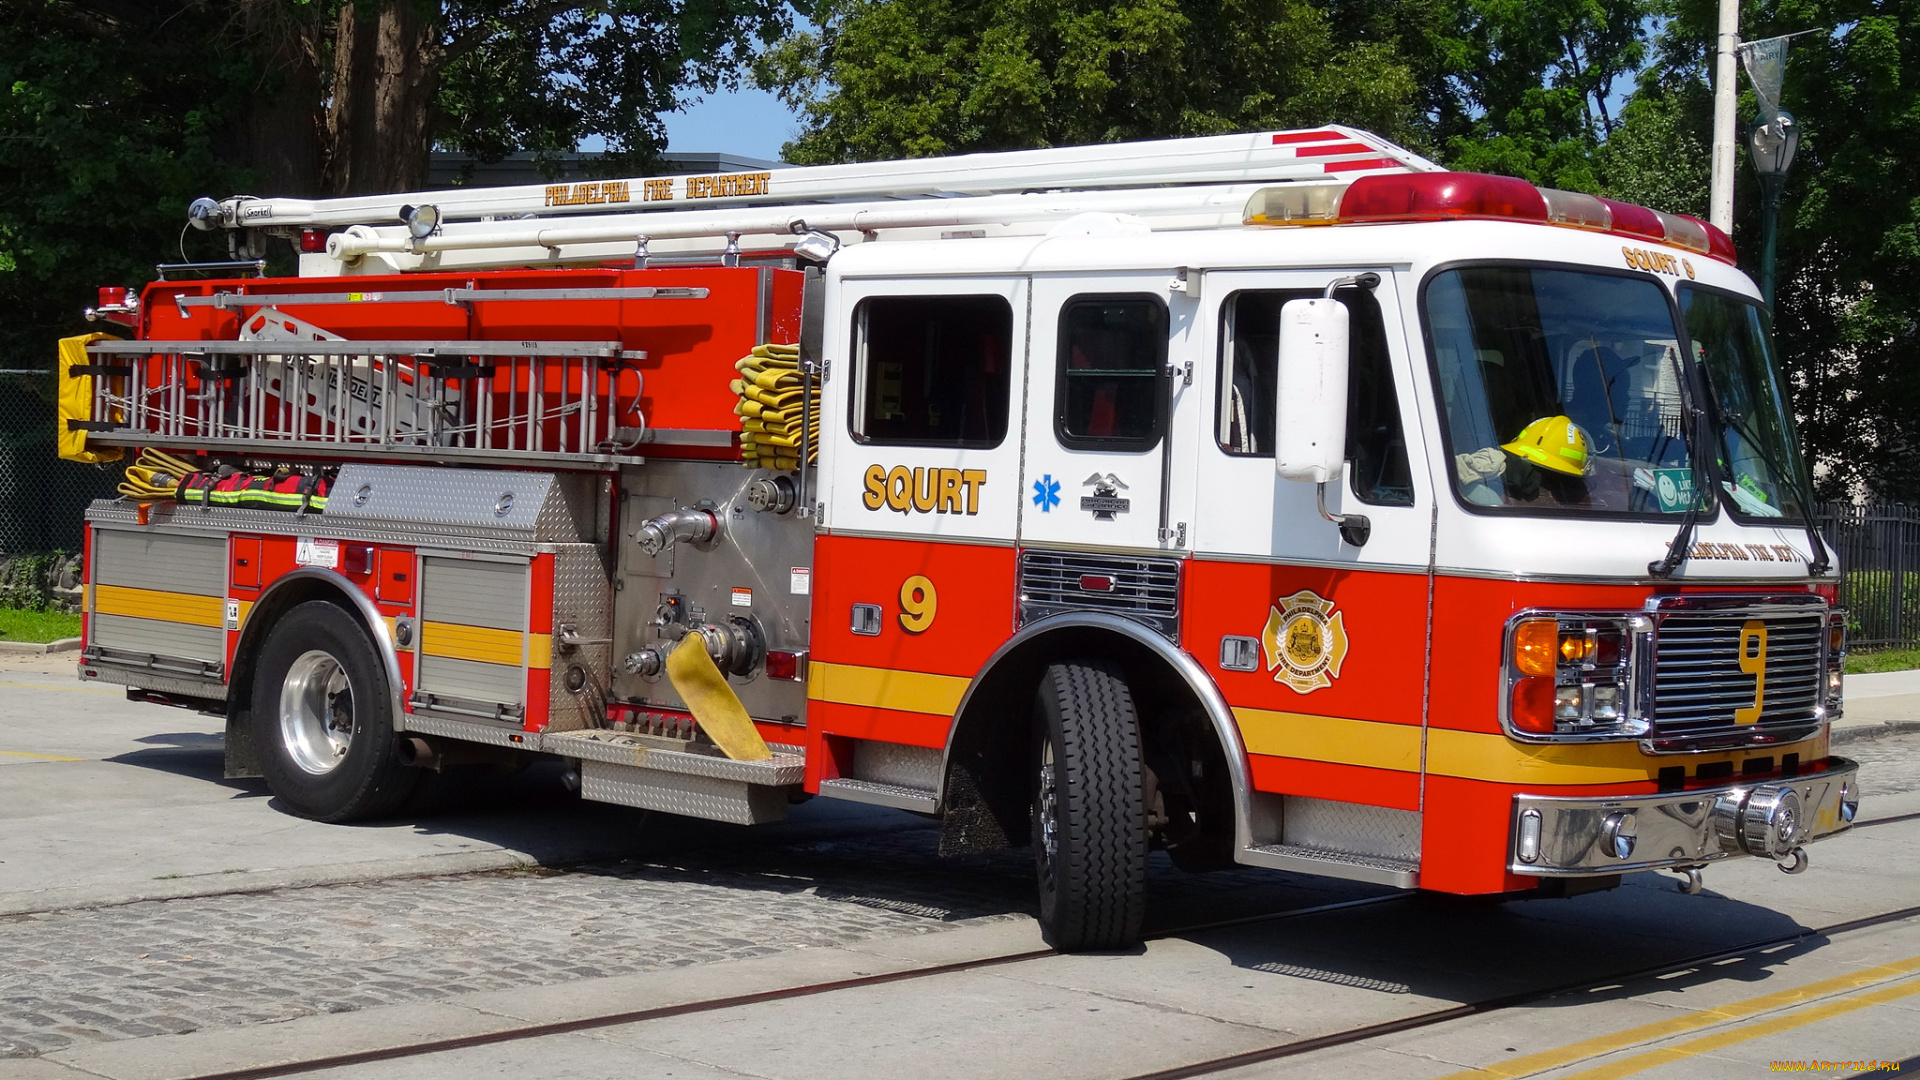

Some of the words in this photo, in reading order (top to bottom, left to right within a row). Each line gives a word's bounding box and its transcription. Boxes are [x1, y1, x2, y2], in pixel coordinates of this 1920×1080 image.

[545, 181, 630, 206] PHILADELPHIA
[643, 178, 674, 201] FIRE
[686, 172, 771, 199] DEPARTMENT
[1621, 246, 1680, 277] SQURT
[1681, 257, 1696, 281] 9
[862, 464, 987, 516] SQURT
[898, 574, 938, 636] 9
[1283, 606, 1328, 625] PHILADELPHIA
[1277, 653, 1290, 671] FIRE
[1290, 655, 1331, 677] DEPARTMENT
[1734, 620, 1768, 725] 9
